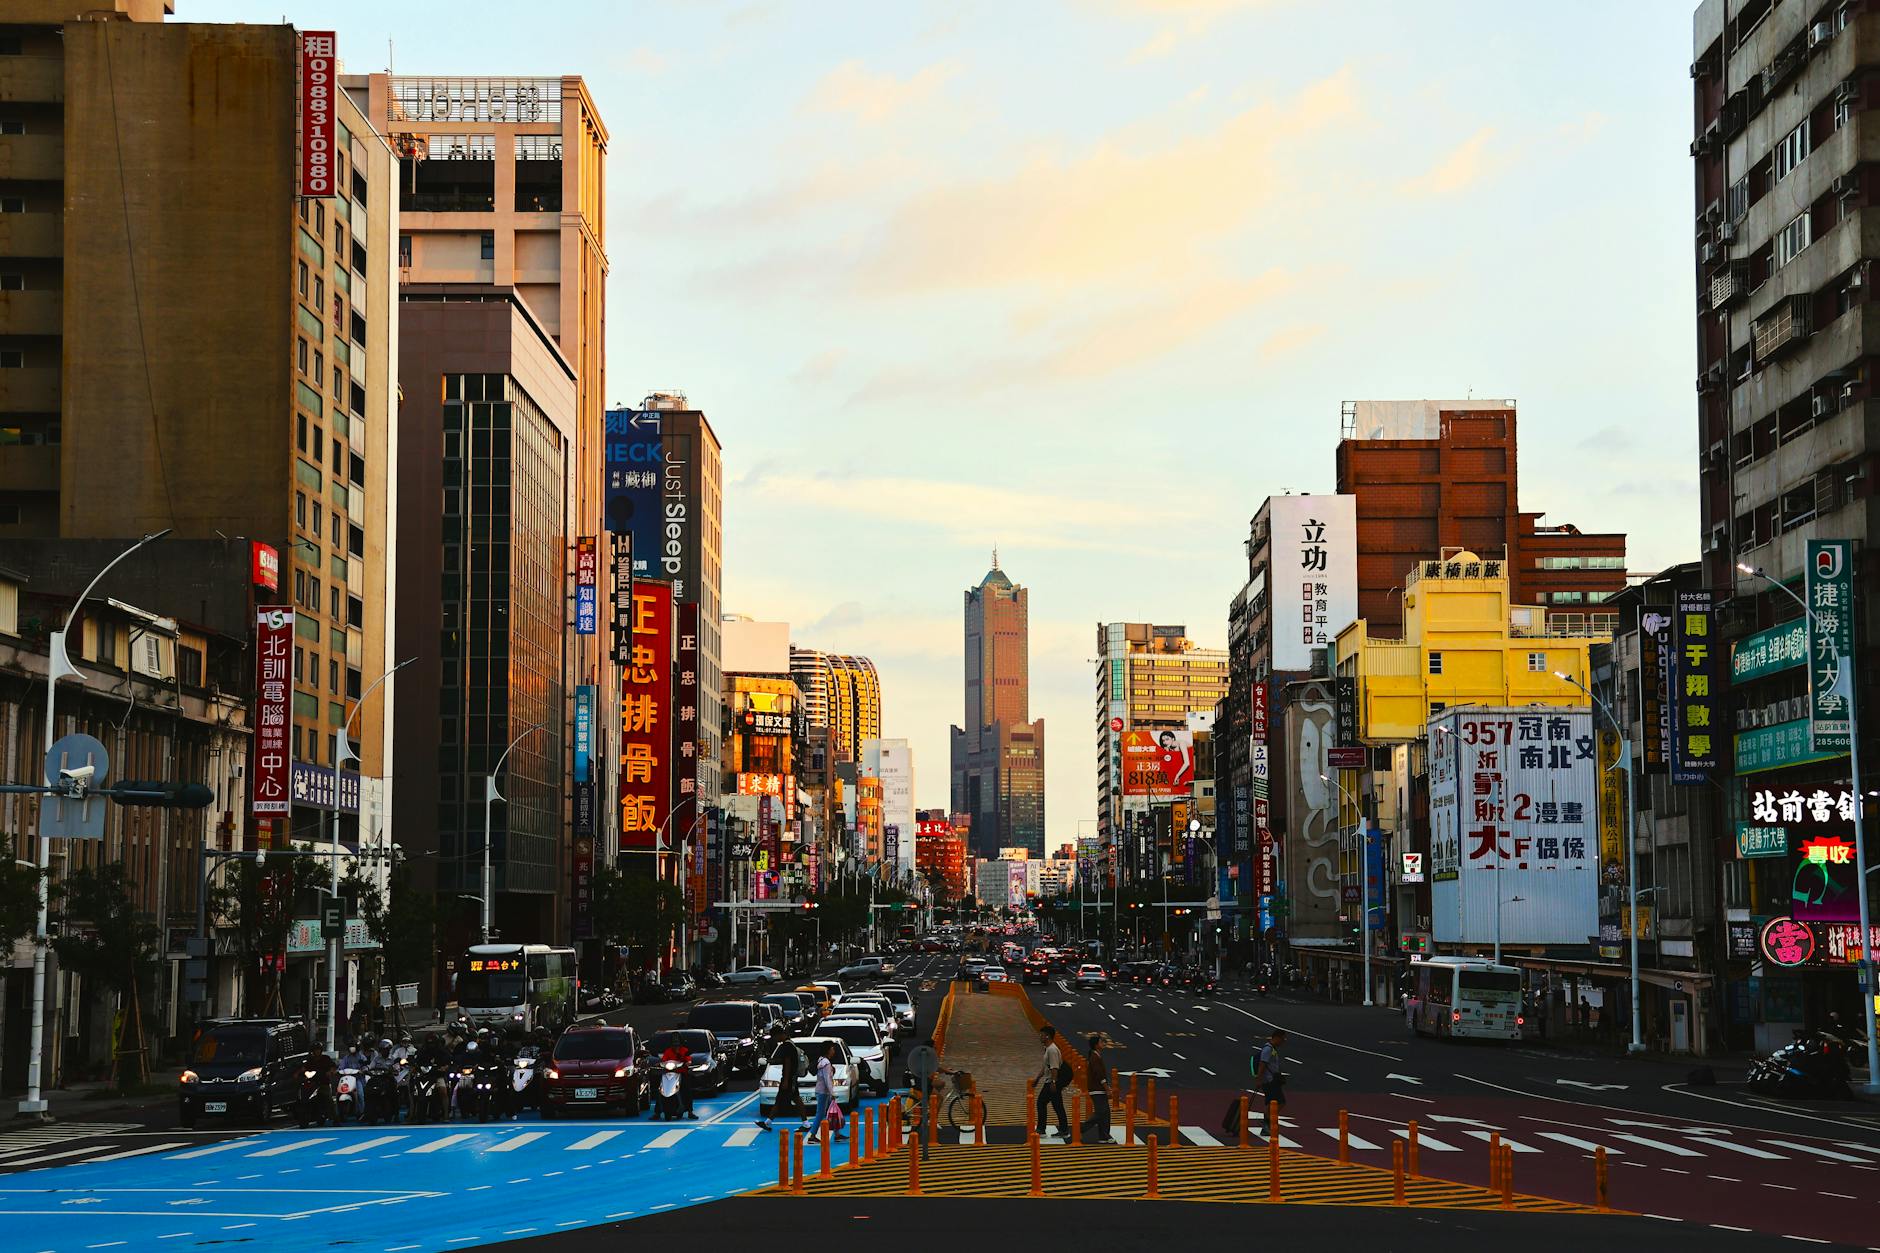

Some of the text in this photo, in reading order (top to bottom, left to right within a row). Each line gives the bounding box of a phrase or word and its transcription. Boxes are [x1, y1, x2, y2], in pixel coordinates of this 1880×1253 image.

[304, 36, 333, 57] 租
[309, 60, 328, 191] 0988310880
[661, 451, 687, 574] Just Sleep
[1301, 518, 1328, 571] 立功
[579, 553, 595, 585] 高點
[618, 556, 631, 609] SINGLE INN
[578, 586, 595, 632] 知識達
[1314, 582, 1329, 644] 教育平台
[1814, 582, 1843, 715] 捷勝升大學
[262, 634, 286, 725] 北訓電腦
[1684, 613, 1712, 758] 周于翔數學
[621, 594, 659, 834] 正忠排骨飯
[680, 634, 695, 794] 正忠排骨飯
[1462, 721, 1513, 746] 357
[260, 752, 283, 797] 中心
[1128, 771, 1168, 785] 818萬
[1255, 748, 1266, 776] 立功
[1535, 802, 1583, 824] 漫畫
[1536, 838, 1585, 859] 偶像
[325, 908, 338, 927] E
[1768, 920, 1809, 963] 當
[502, 959, 519, 971] 台中
[1674, 981, 1683, 991] C
